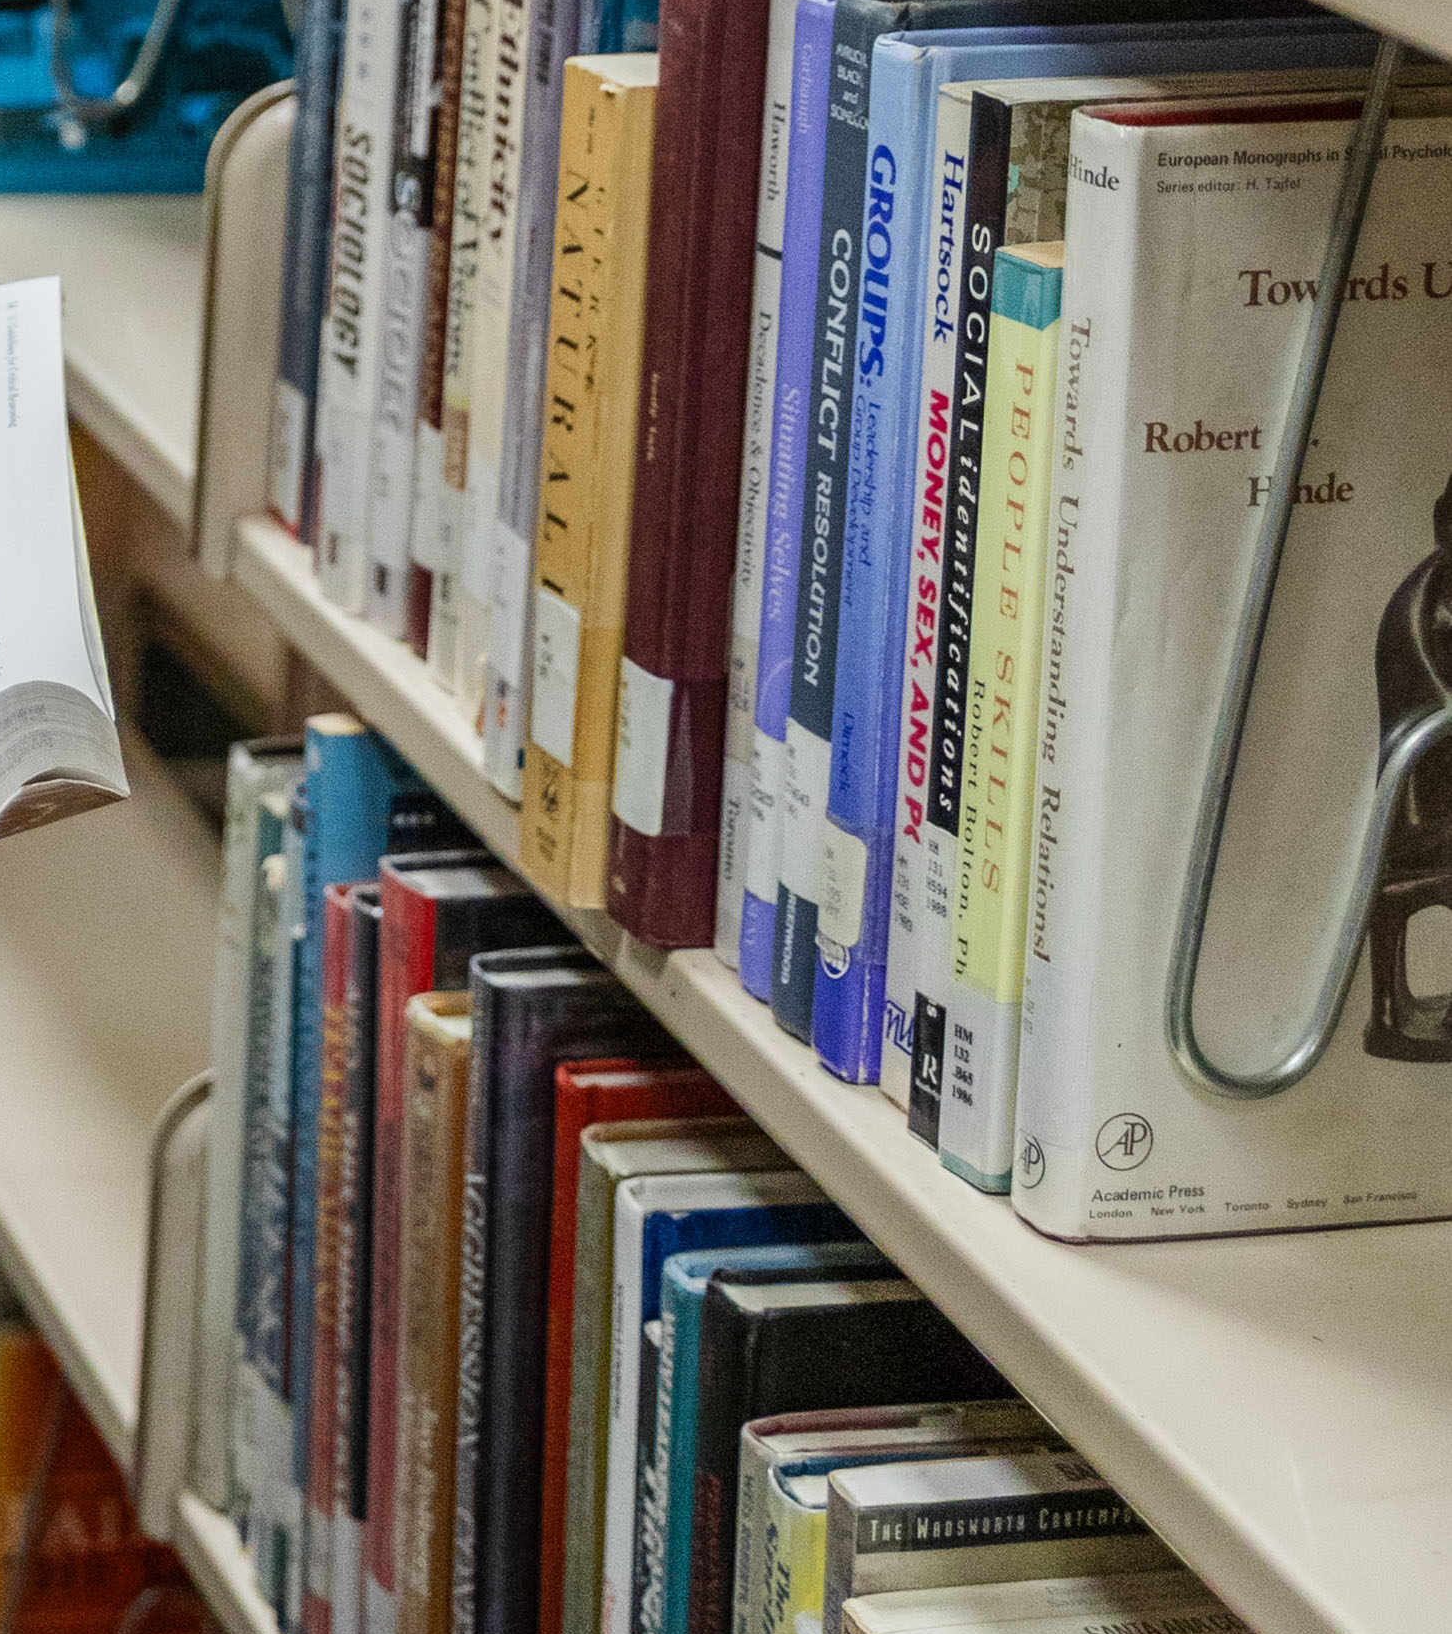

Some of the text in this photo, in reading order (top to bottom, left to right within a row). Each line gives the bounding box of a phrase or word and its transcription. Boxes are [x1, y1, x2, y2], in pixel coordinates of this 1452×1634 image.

[764, 100, 787, 202] Haworth
[1156, 146, 1340, 171] European Monographs in
[1156, 176, 1263, 196] Series editor: H.
[331, 122, 373, 380] SOCIOLOGY
[856, 143, 896, 389] GROUPS:
[934, 148, 966, 345] Hartsock
[1238, 262, 1408, 309] Towrds
[739, 311, 772, 590] Decadence Objectivity
[801, 228, 853, 688] CONFLICT RESOLUTION
[855, 402, 882, 567] Leadership and
[1143, 417, 1263, 454] Robert
[1248, 473, 1355, 508] Hnde
[766, 383, 803, 623] Situating Selves
[937, 222, 992, 814] SOCIAL identifications
[1041, 315, 1093, 766] Towards Understanding
[905, 388, 949, 787] MONEY, SEX, AND
[981, 362, 1035, 896] PEOPLE SKILLS
[957, 679, 987, 922] Robert Bolton,
[950, 1084, 975, 1109] 1986
[953, 1025, 975, 1046] HM
[953, 1044, 971, 1066] 132
[1091, 1183, 1206, 1204] Academic Press
[1150, 1204, 1176, 1217] New
[1178, 1204, 1207, 1217] York
[869, 1517, 904, 1543] THE
